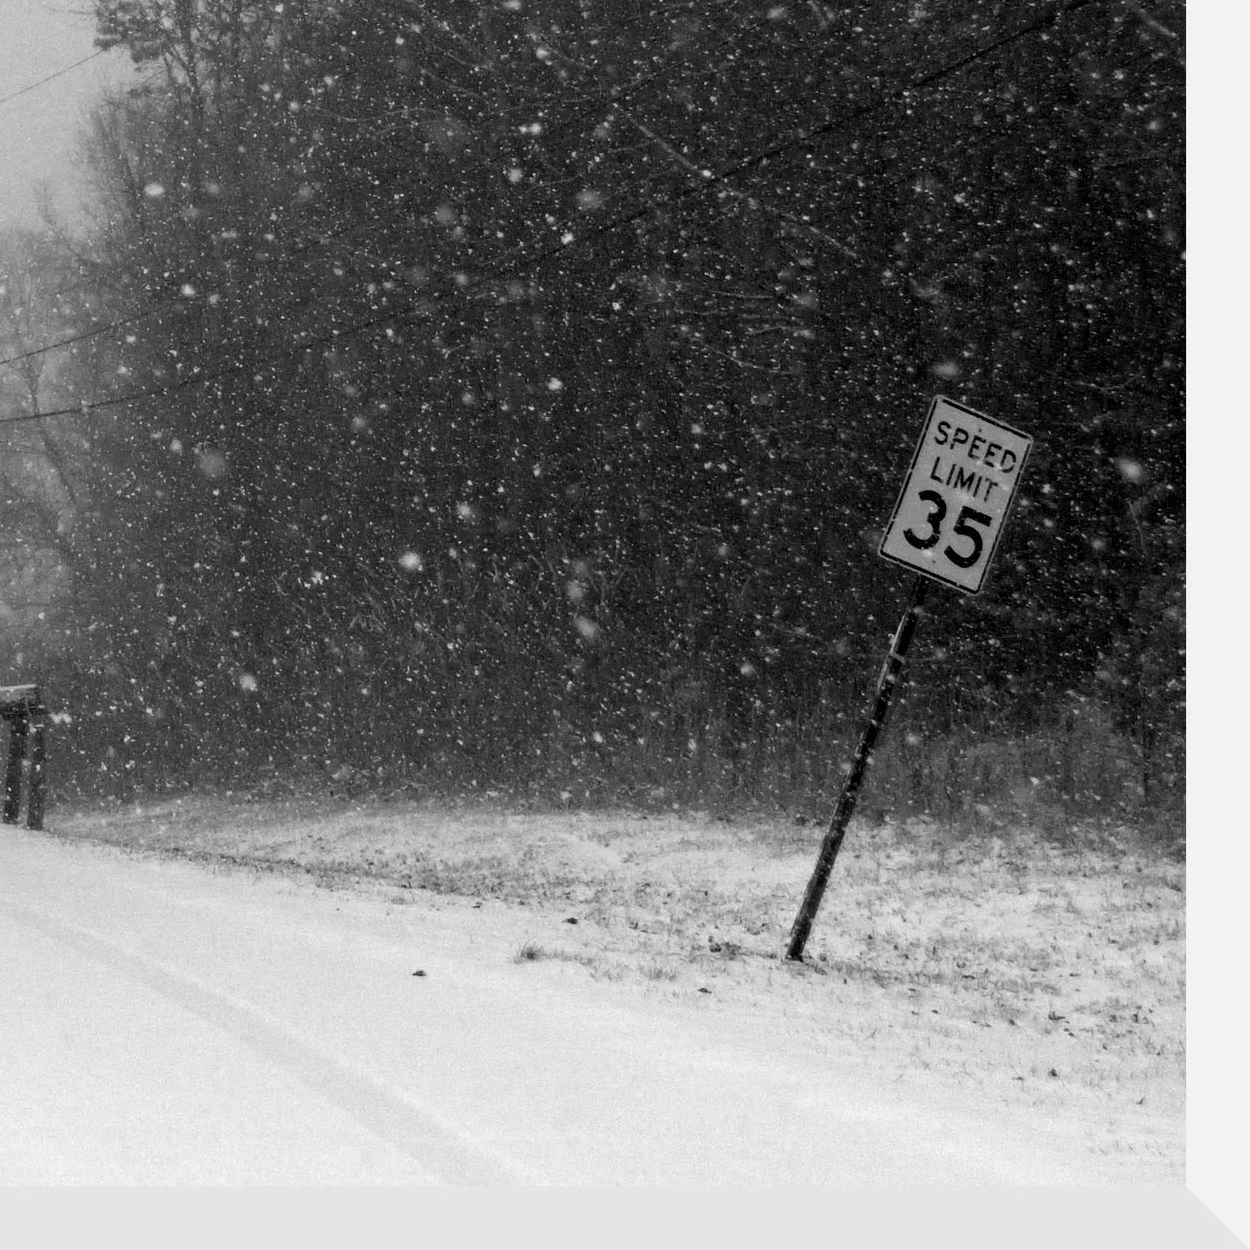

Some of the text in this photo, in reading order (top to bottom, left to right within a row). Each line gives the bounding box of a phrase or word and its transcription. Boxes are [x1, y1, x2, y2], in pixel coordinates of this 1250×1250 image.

[934, 421, 1017, 473] SPEED
[930, 456, 998, 502] LIMIT
[903, 490, 992, 568] 35
